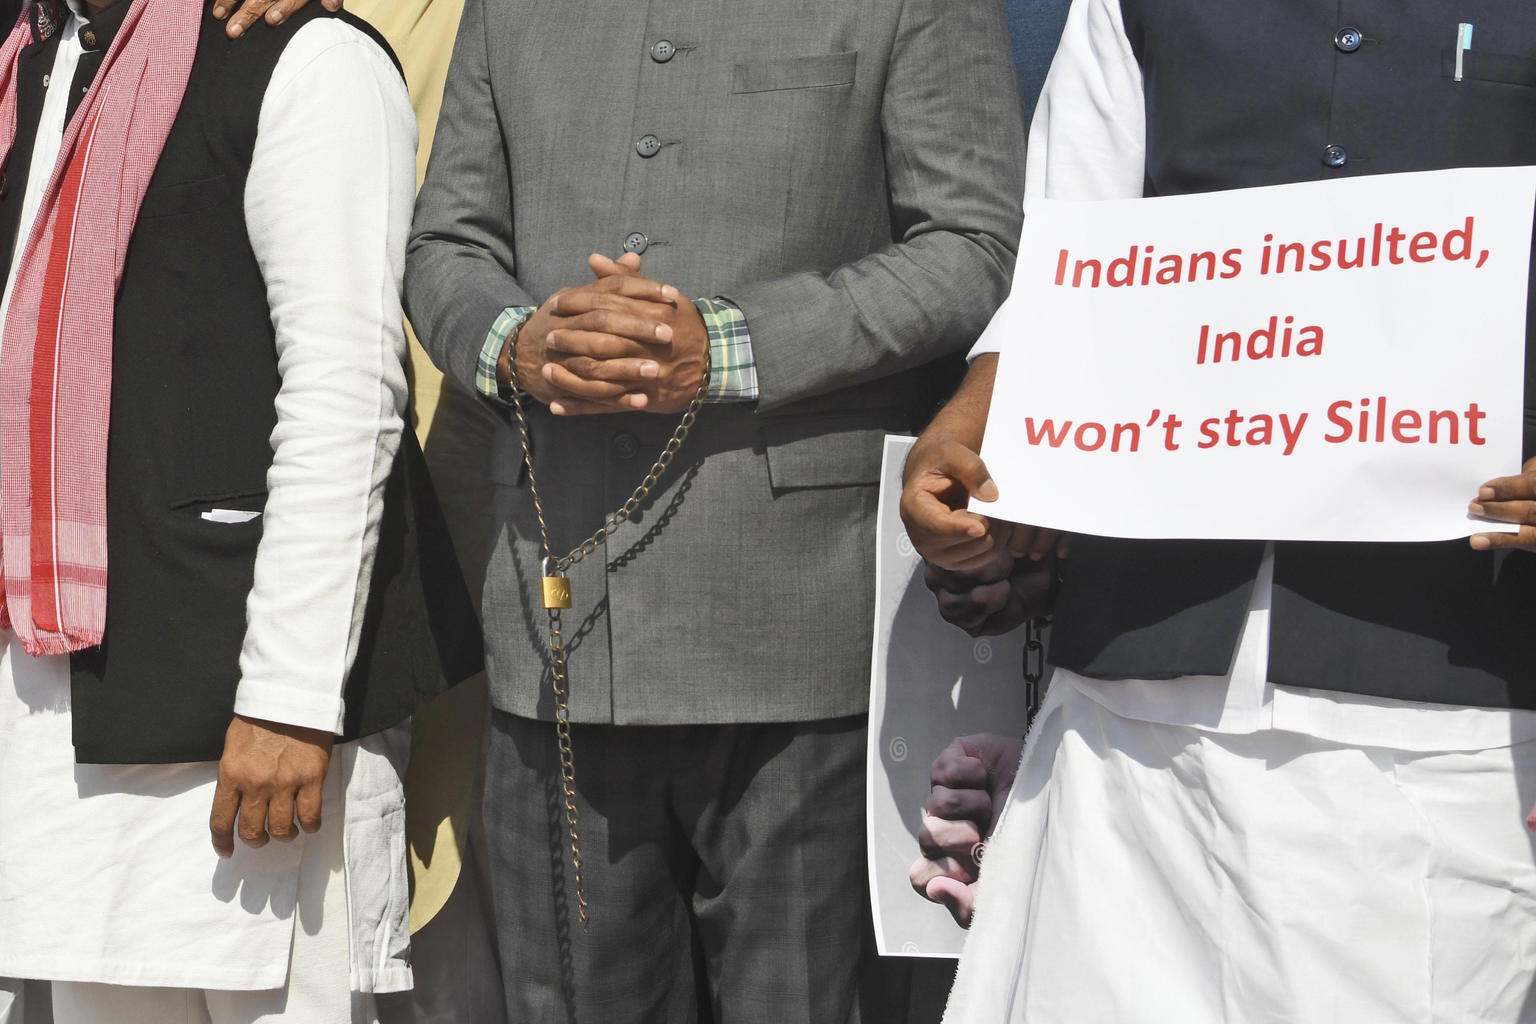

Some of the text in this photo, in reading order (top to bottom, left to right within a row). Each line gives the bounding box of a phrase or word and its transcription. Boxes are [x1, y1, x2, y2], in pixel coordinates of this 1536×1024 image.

[1054, 216, 1490, 289] Indians insulted,
[1196, 315, 1324, 366] India
[1024, 395, 1487, 457] won’t stay Silent
